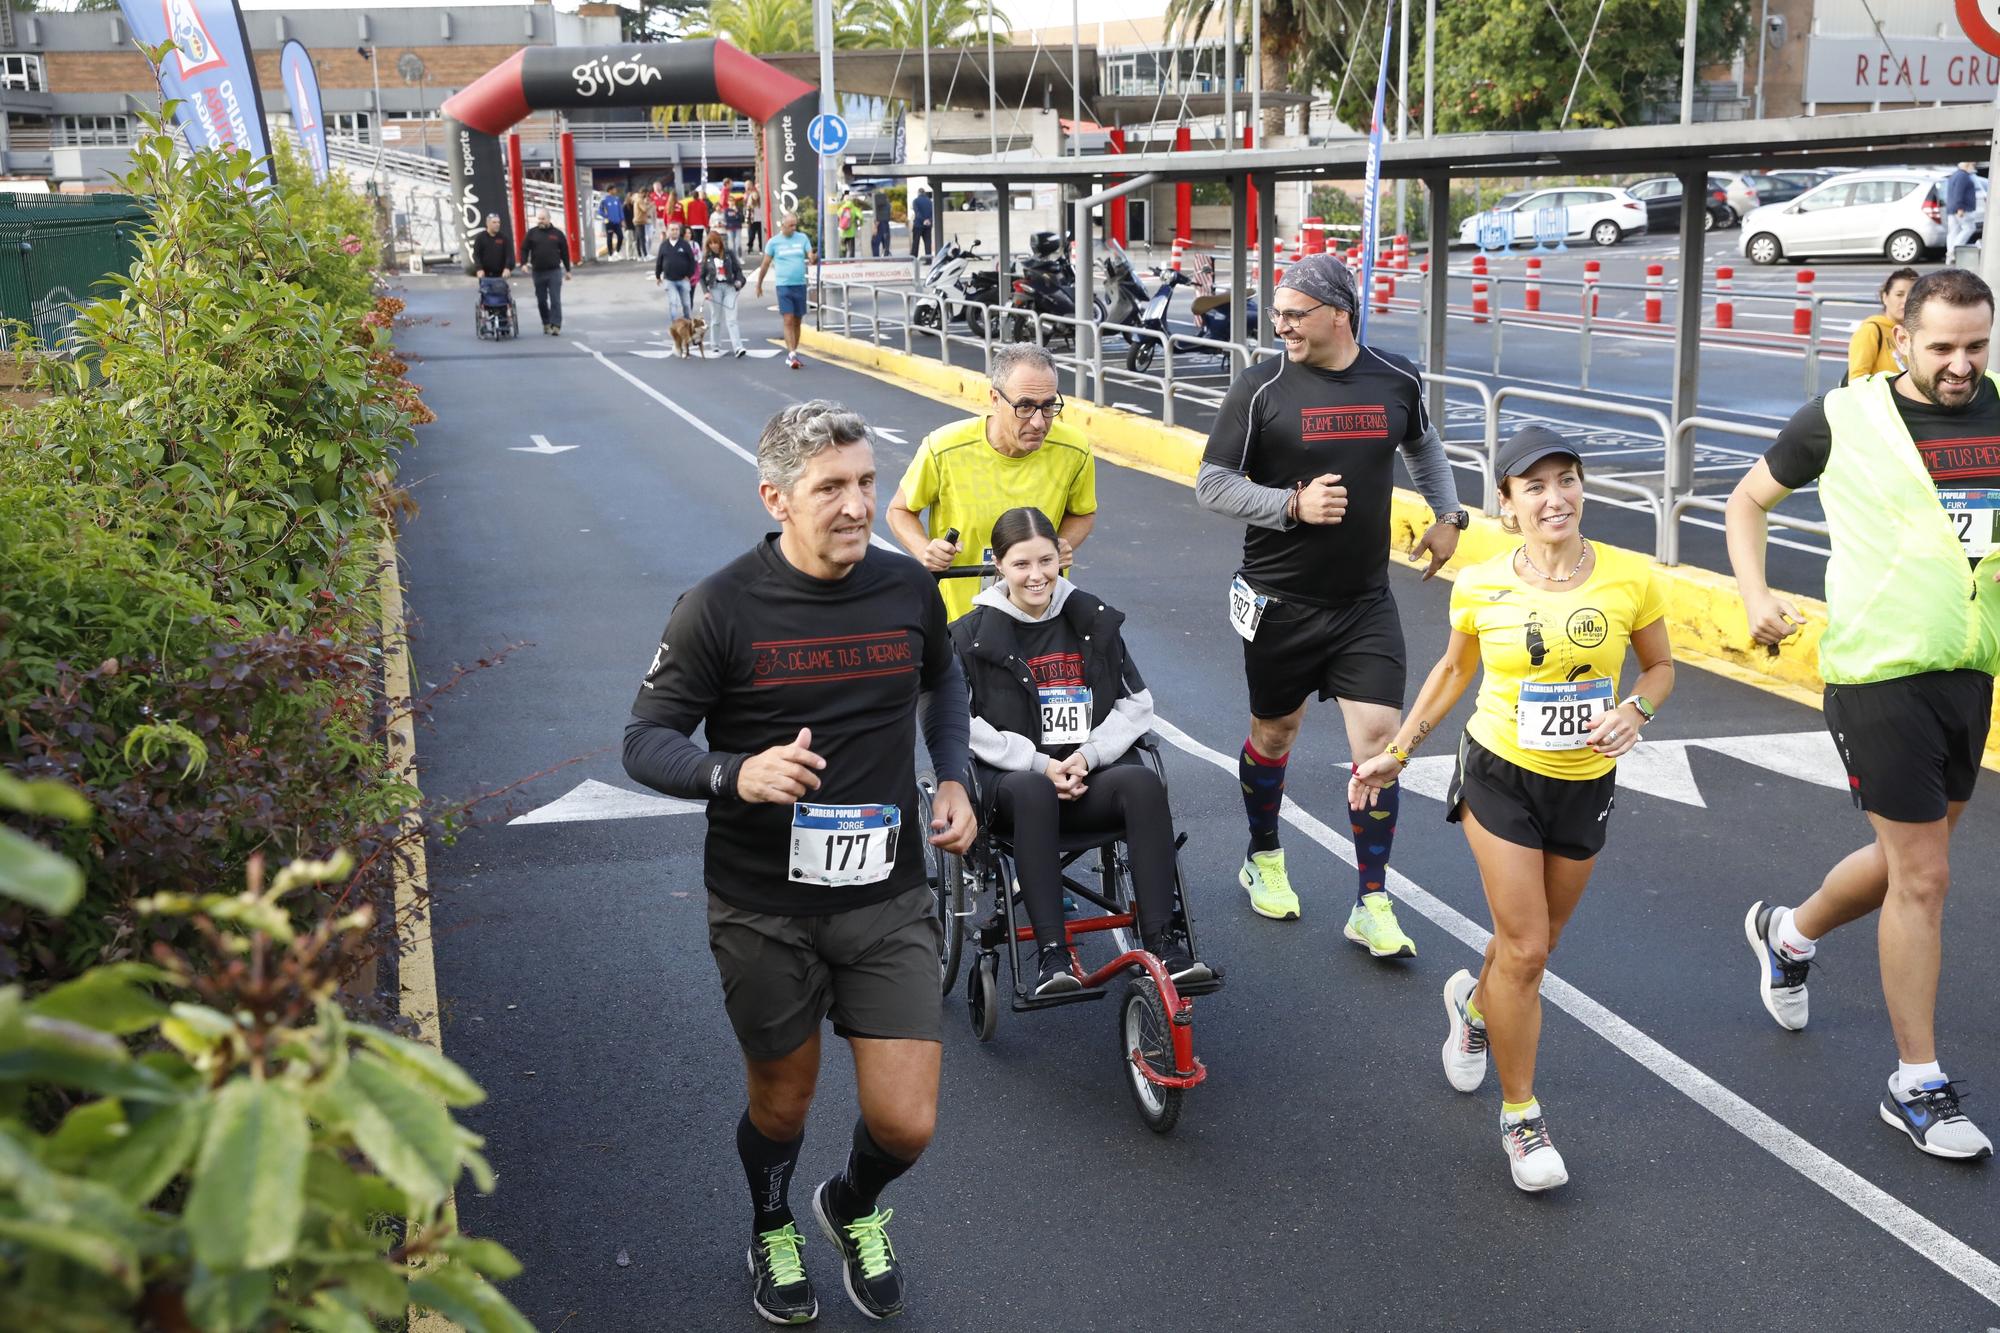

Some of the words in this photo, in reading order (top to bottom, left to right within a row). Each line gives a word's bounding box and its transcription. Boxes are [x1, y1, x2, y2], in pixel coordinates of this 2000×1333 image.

[572, 54, 662, 97] gijón
[1856, 54, 1930, 86] REAL
[781, 115, 796, 162] Deporte
[460, 130, 475, 176] Deporte
[1335, 415, 1354, 431] TUS
[1355, 414, 1388, 430] PIERNAS
[1944, 448, 1973, 468] TUS
[1946, 501, 1968, 509] FURY
[1581, 620, 1594, 633] 10
[837, 648, 862, 667] TUS
[866, 642, 912, 663] PIERNAS
[1558, 693, 1579, 702] LOLI
[1043, 706, 1078, 732] 346
[1541, 703, 1592, 736] 288
[835, 808, 861, 818] POPULAR
[837, 821, 865, 830] JORGE
[825, 833, 871, 871] 177
